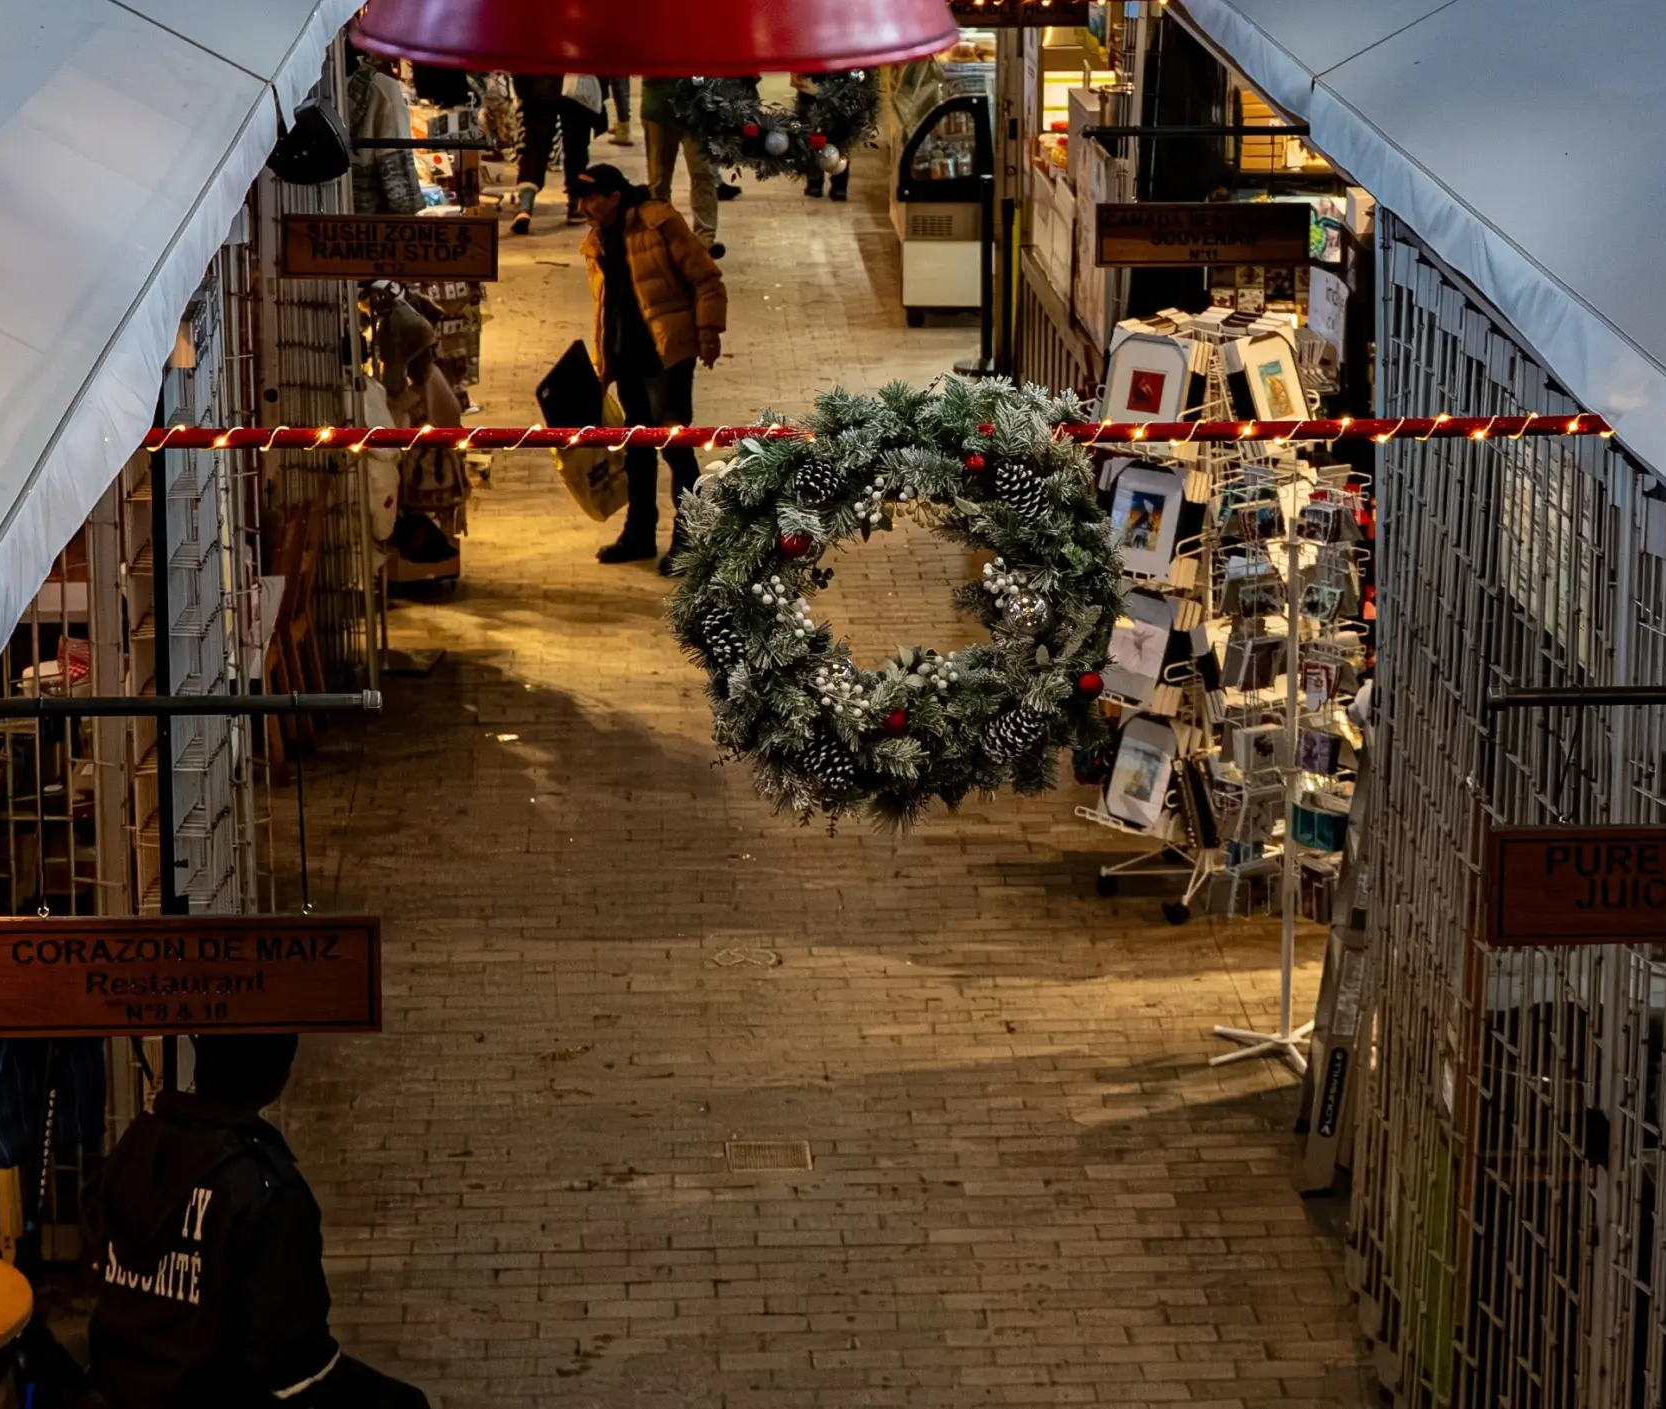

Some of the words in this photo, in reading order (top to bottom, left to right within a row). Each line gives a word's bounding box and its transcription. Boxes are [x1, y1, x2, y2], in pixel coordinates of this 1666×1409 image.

[306, 223, 377, 242] SUSHI
[385, 224, 450, 243] ZONE
[455, 225, 472, 243] &
[311, 242, 396, 261] RAMEN
[403, 244, 467, 262] STOP
[1545, 844, 1660, 876] PURE
[11, 938, 186, 965] CORAZON
[198, 938, 243, 962] DE
[256, 935, 341, 961] MAIZ
[85, 969, 267, 996] Restaurant
[1324, 1051, 1343, 1124] LOUISVILLE
